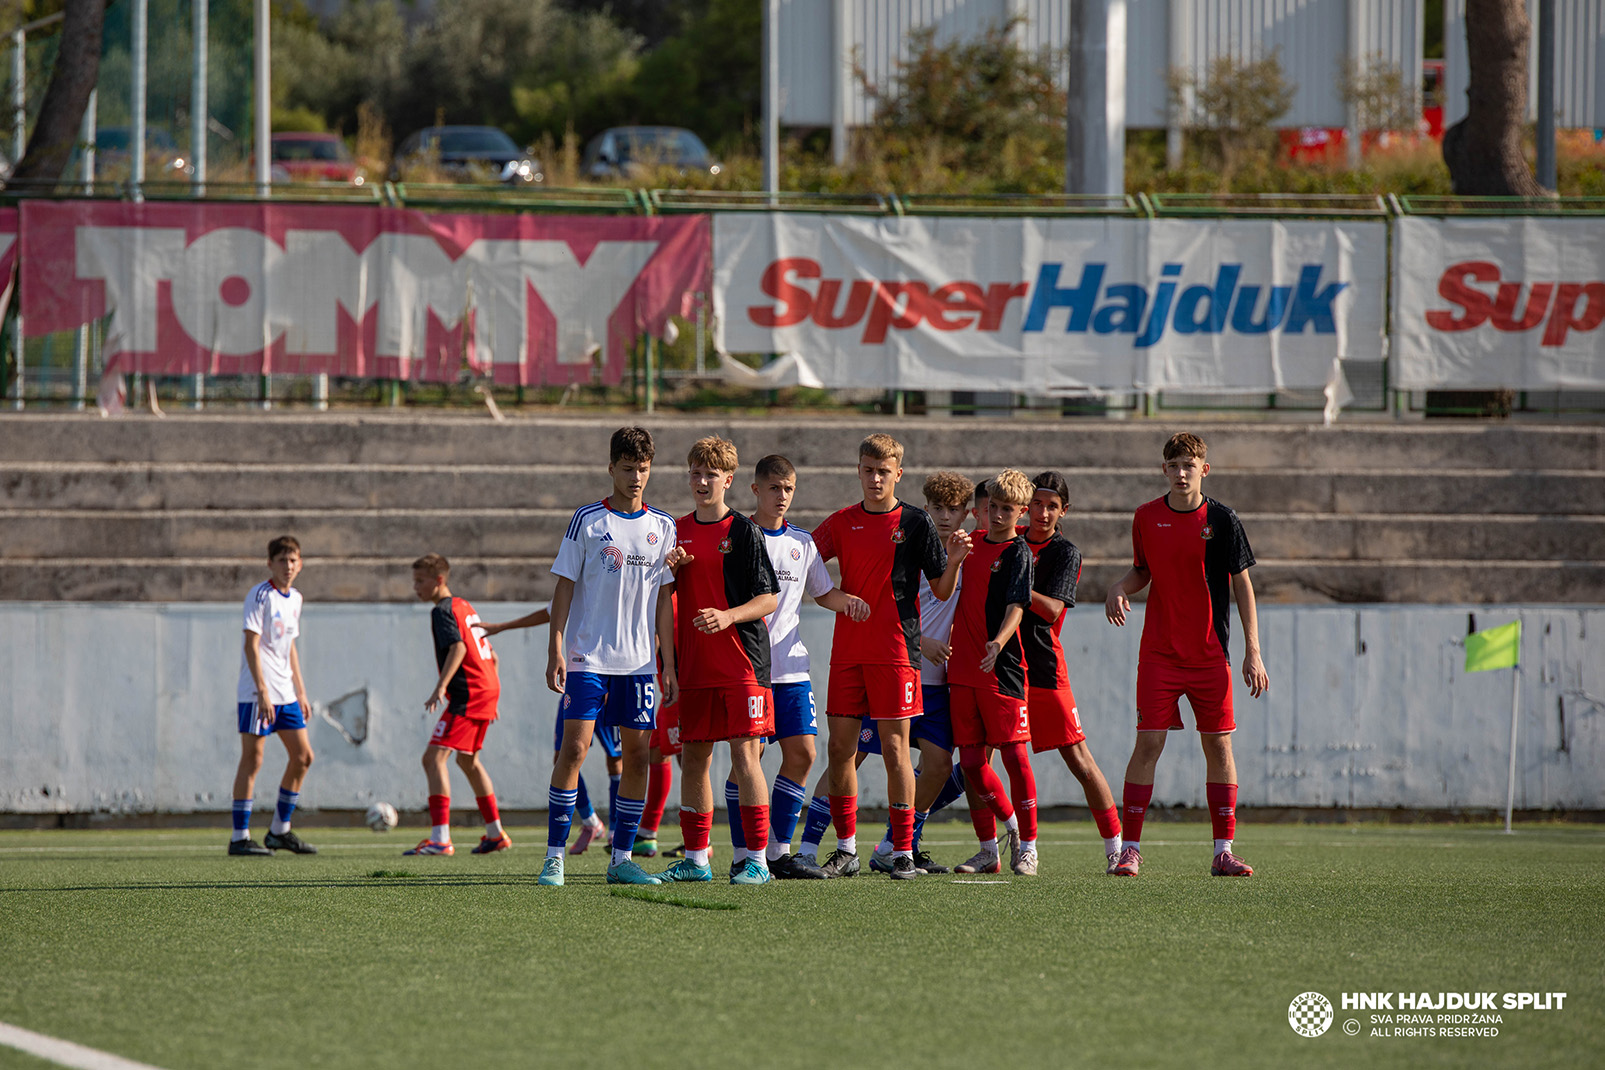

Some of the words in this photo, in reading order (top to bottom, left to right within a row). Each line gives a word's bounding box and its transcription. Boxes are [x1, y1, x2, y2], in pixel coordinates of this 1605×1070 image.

[74, 226, 660, 366] TOMMY
[635, 682, 655, 710] 15
[905, 681, 913, 703] 6
[747, 695, 764, 718] 80
[1019, 706, 1028, 727] 5
